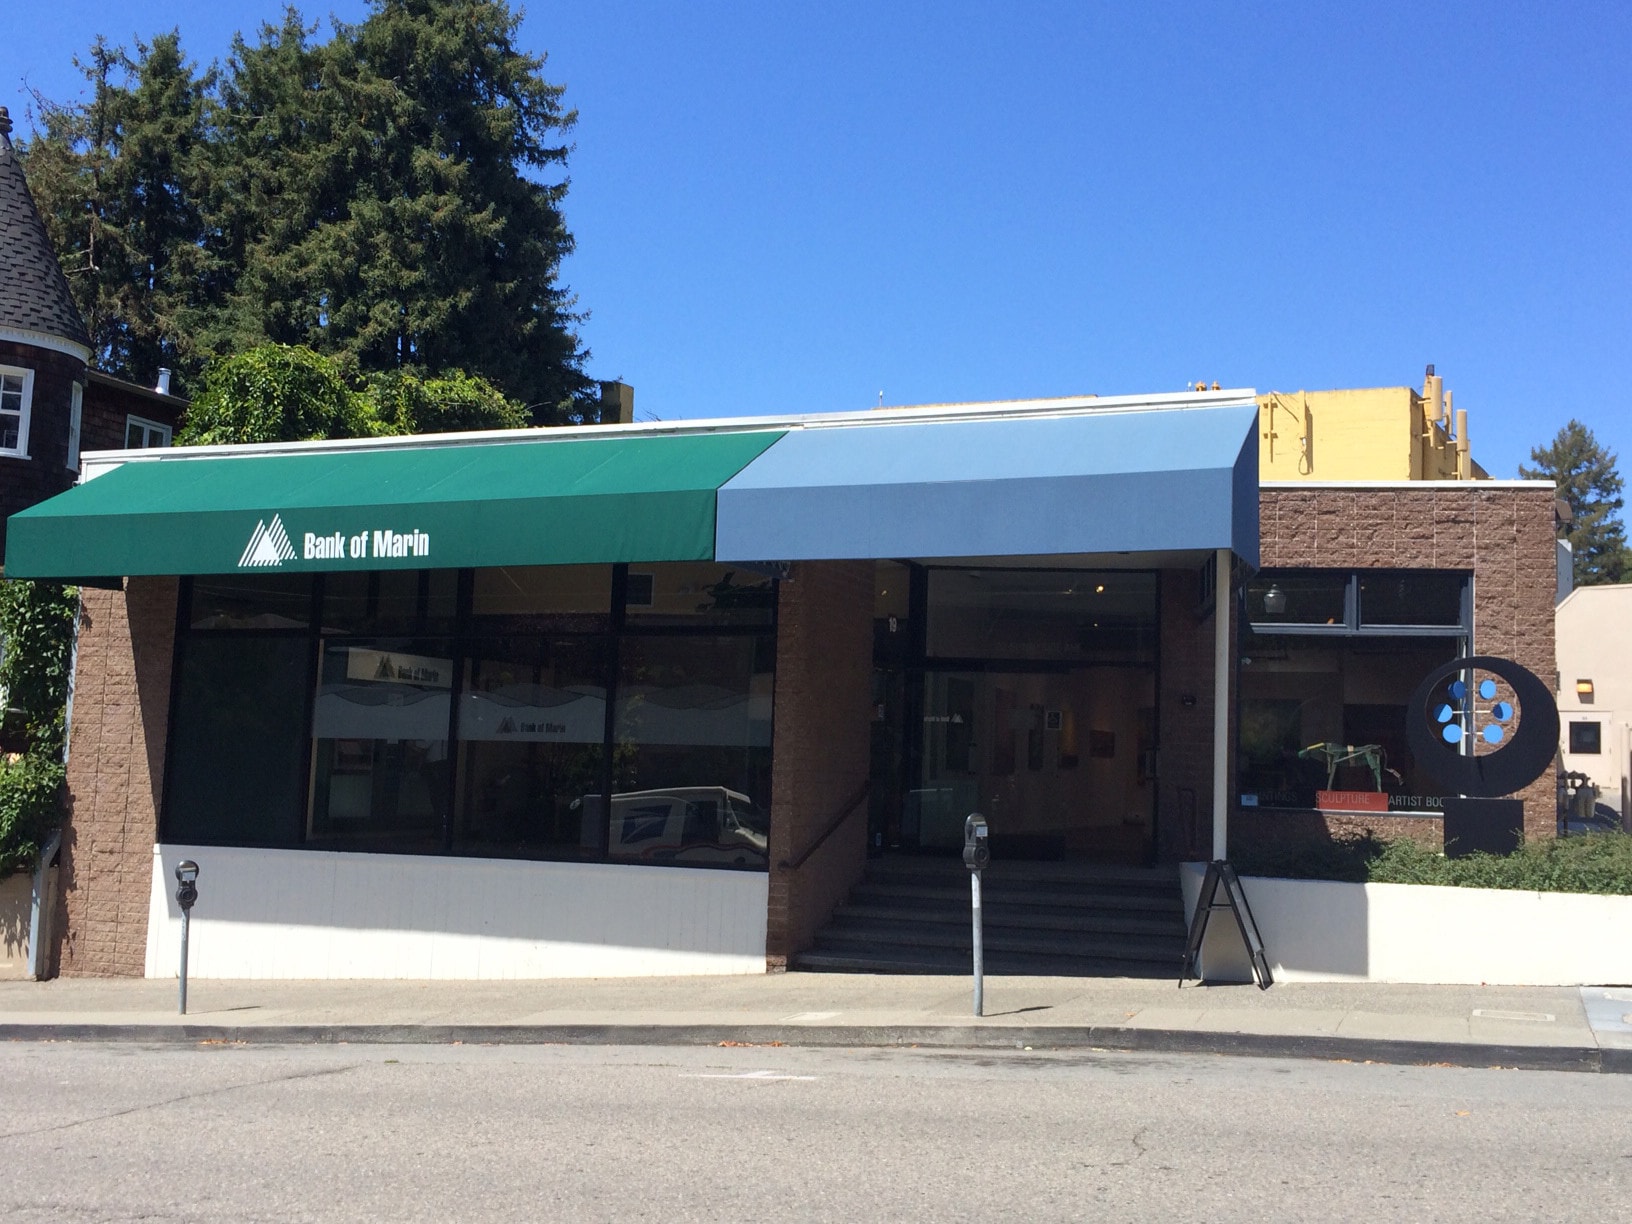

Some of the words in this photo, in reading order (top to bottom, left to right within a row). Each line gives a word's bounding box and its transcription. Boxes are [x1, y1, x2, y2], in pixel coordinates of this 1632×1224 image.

[304, 531, 345, 559] Bank
[350, 531, 369, 558] of
[373, 529, 429, 557] Marin
[1315, 792, 1370, 805] SCULPTURE
[1388, 795, 1423, 807] ARTIST
[1426, 796, 1444, 808] BOO
